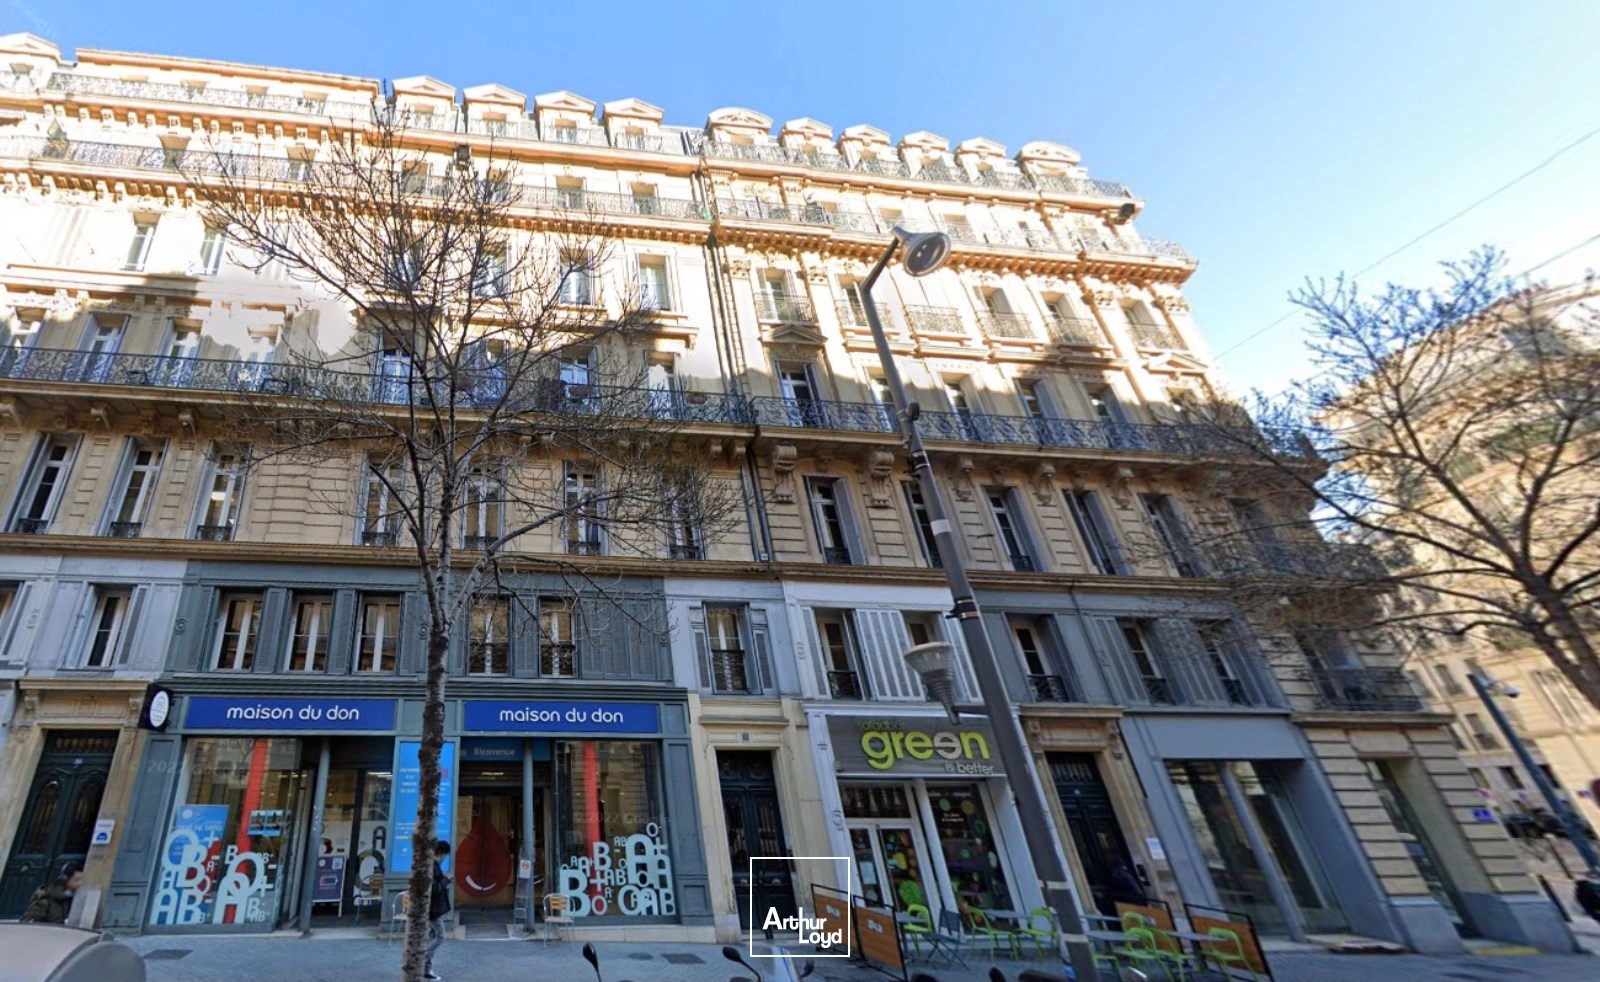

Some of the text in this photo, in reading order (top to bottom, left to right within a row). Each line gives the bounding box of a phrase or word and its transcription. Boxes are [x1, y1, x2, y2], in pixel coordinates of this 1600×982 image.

[226, 704, 360, 720] maison du don
[499, 707, 624, 723] maison du don
[474, 747, 515, 756] Bienvenue
[861, 731, 991, 770] green
[945, 762, 994, 775] is better
